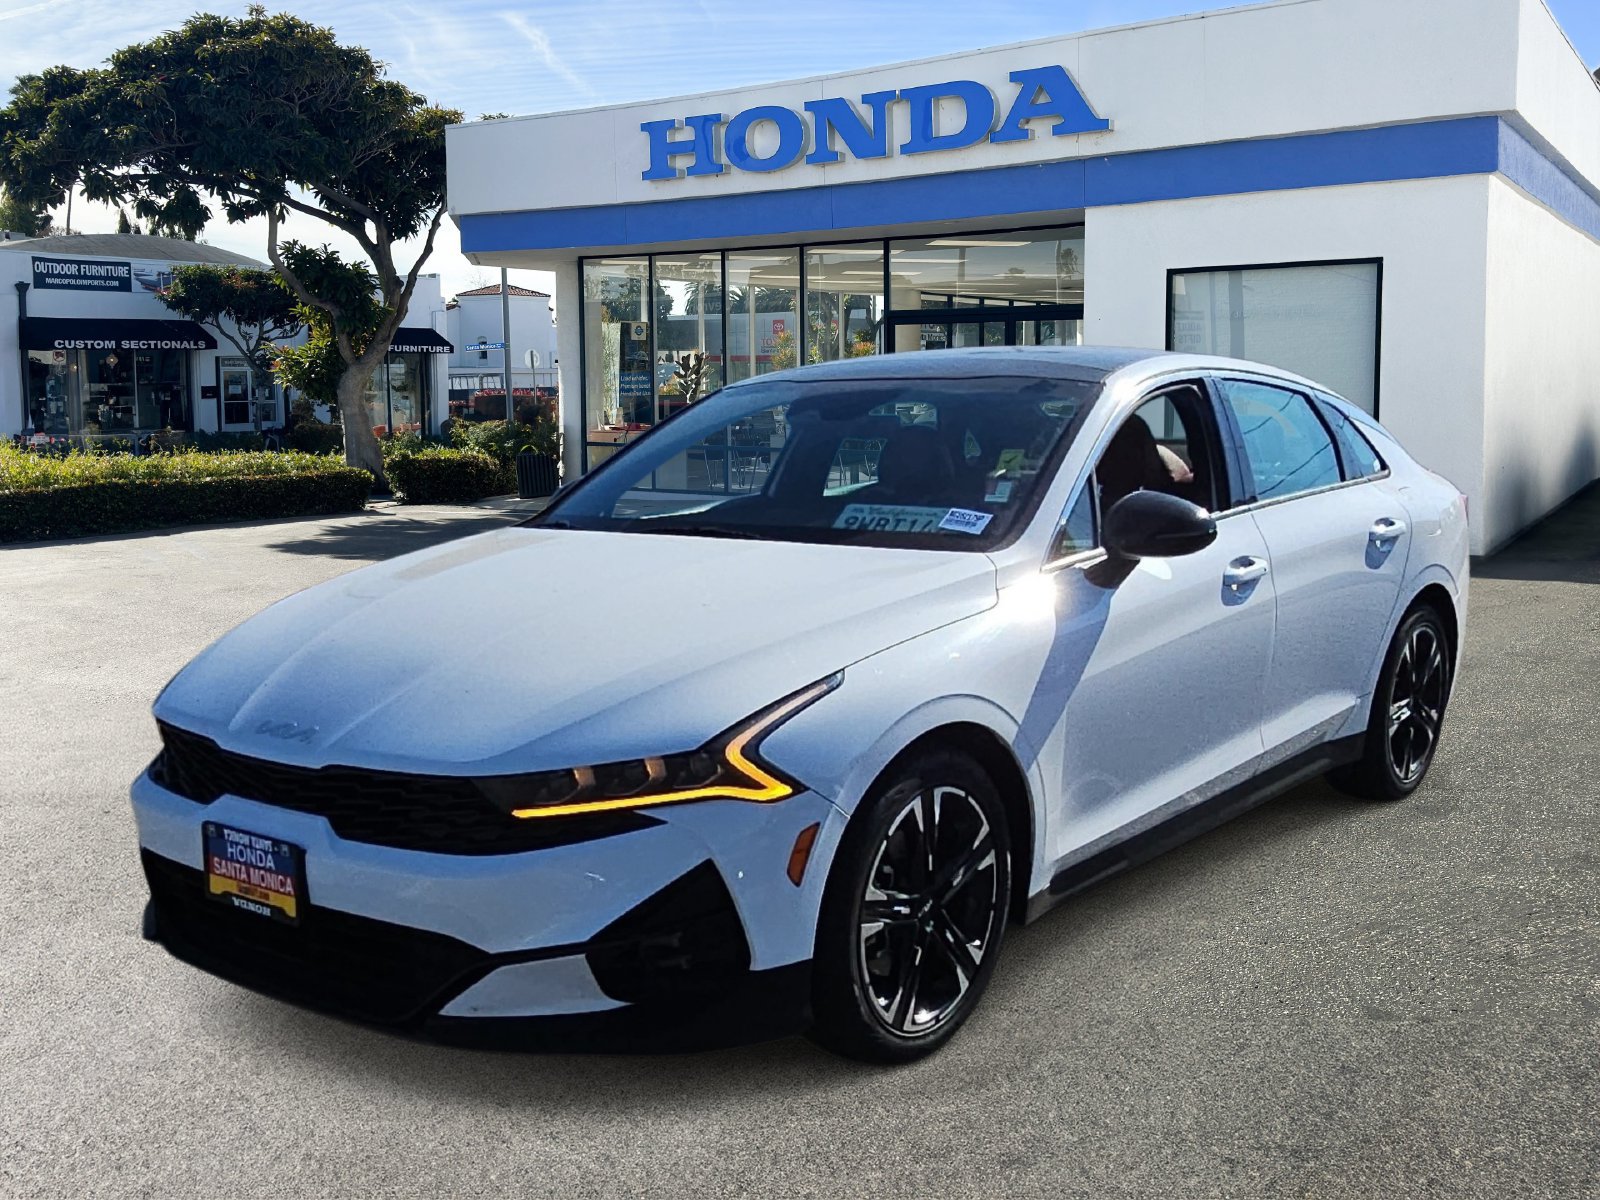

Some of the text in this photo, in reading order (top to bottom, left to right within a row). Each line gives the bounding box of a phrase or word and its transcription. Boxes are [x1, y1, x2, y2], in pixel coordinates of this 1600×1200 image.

[640, 64, 1112, 181] HONDA
[34, 261, 130, 277] OUTDOOR FURNITURE
[45, 277, 119, 287] MARCOPOLOIMPORTS.COM
[54, 339, 206, 349] CUSTOM SECTIONALS
[388, 344, 451, 353] FURNITURE
[227, 842, 276, 870] HONDA
[213, 857, 248, 882] SANTA
[249, 867, 295, 895] MONICA
[231, 896, 272, 916] HONDA
